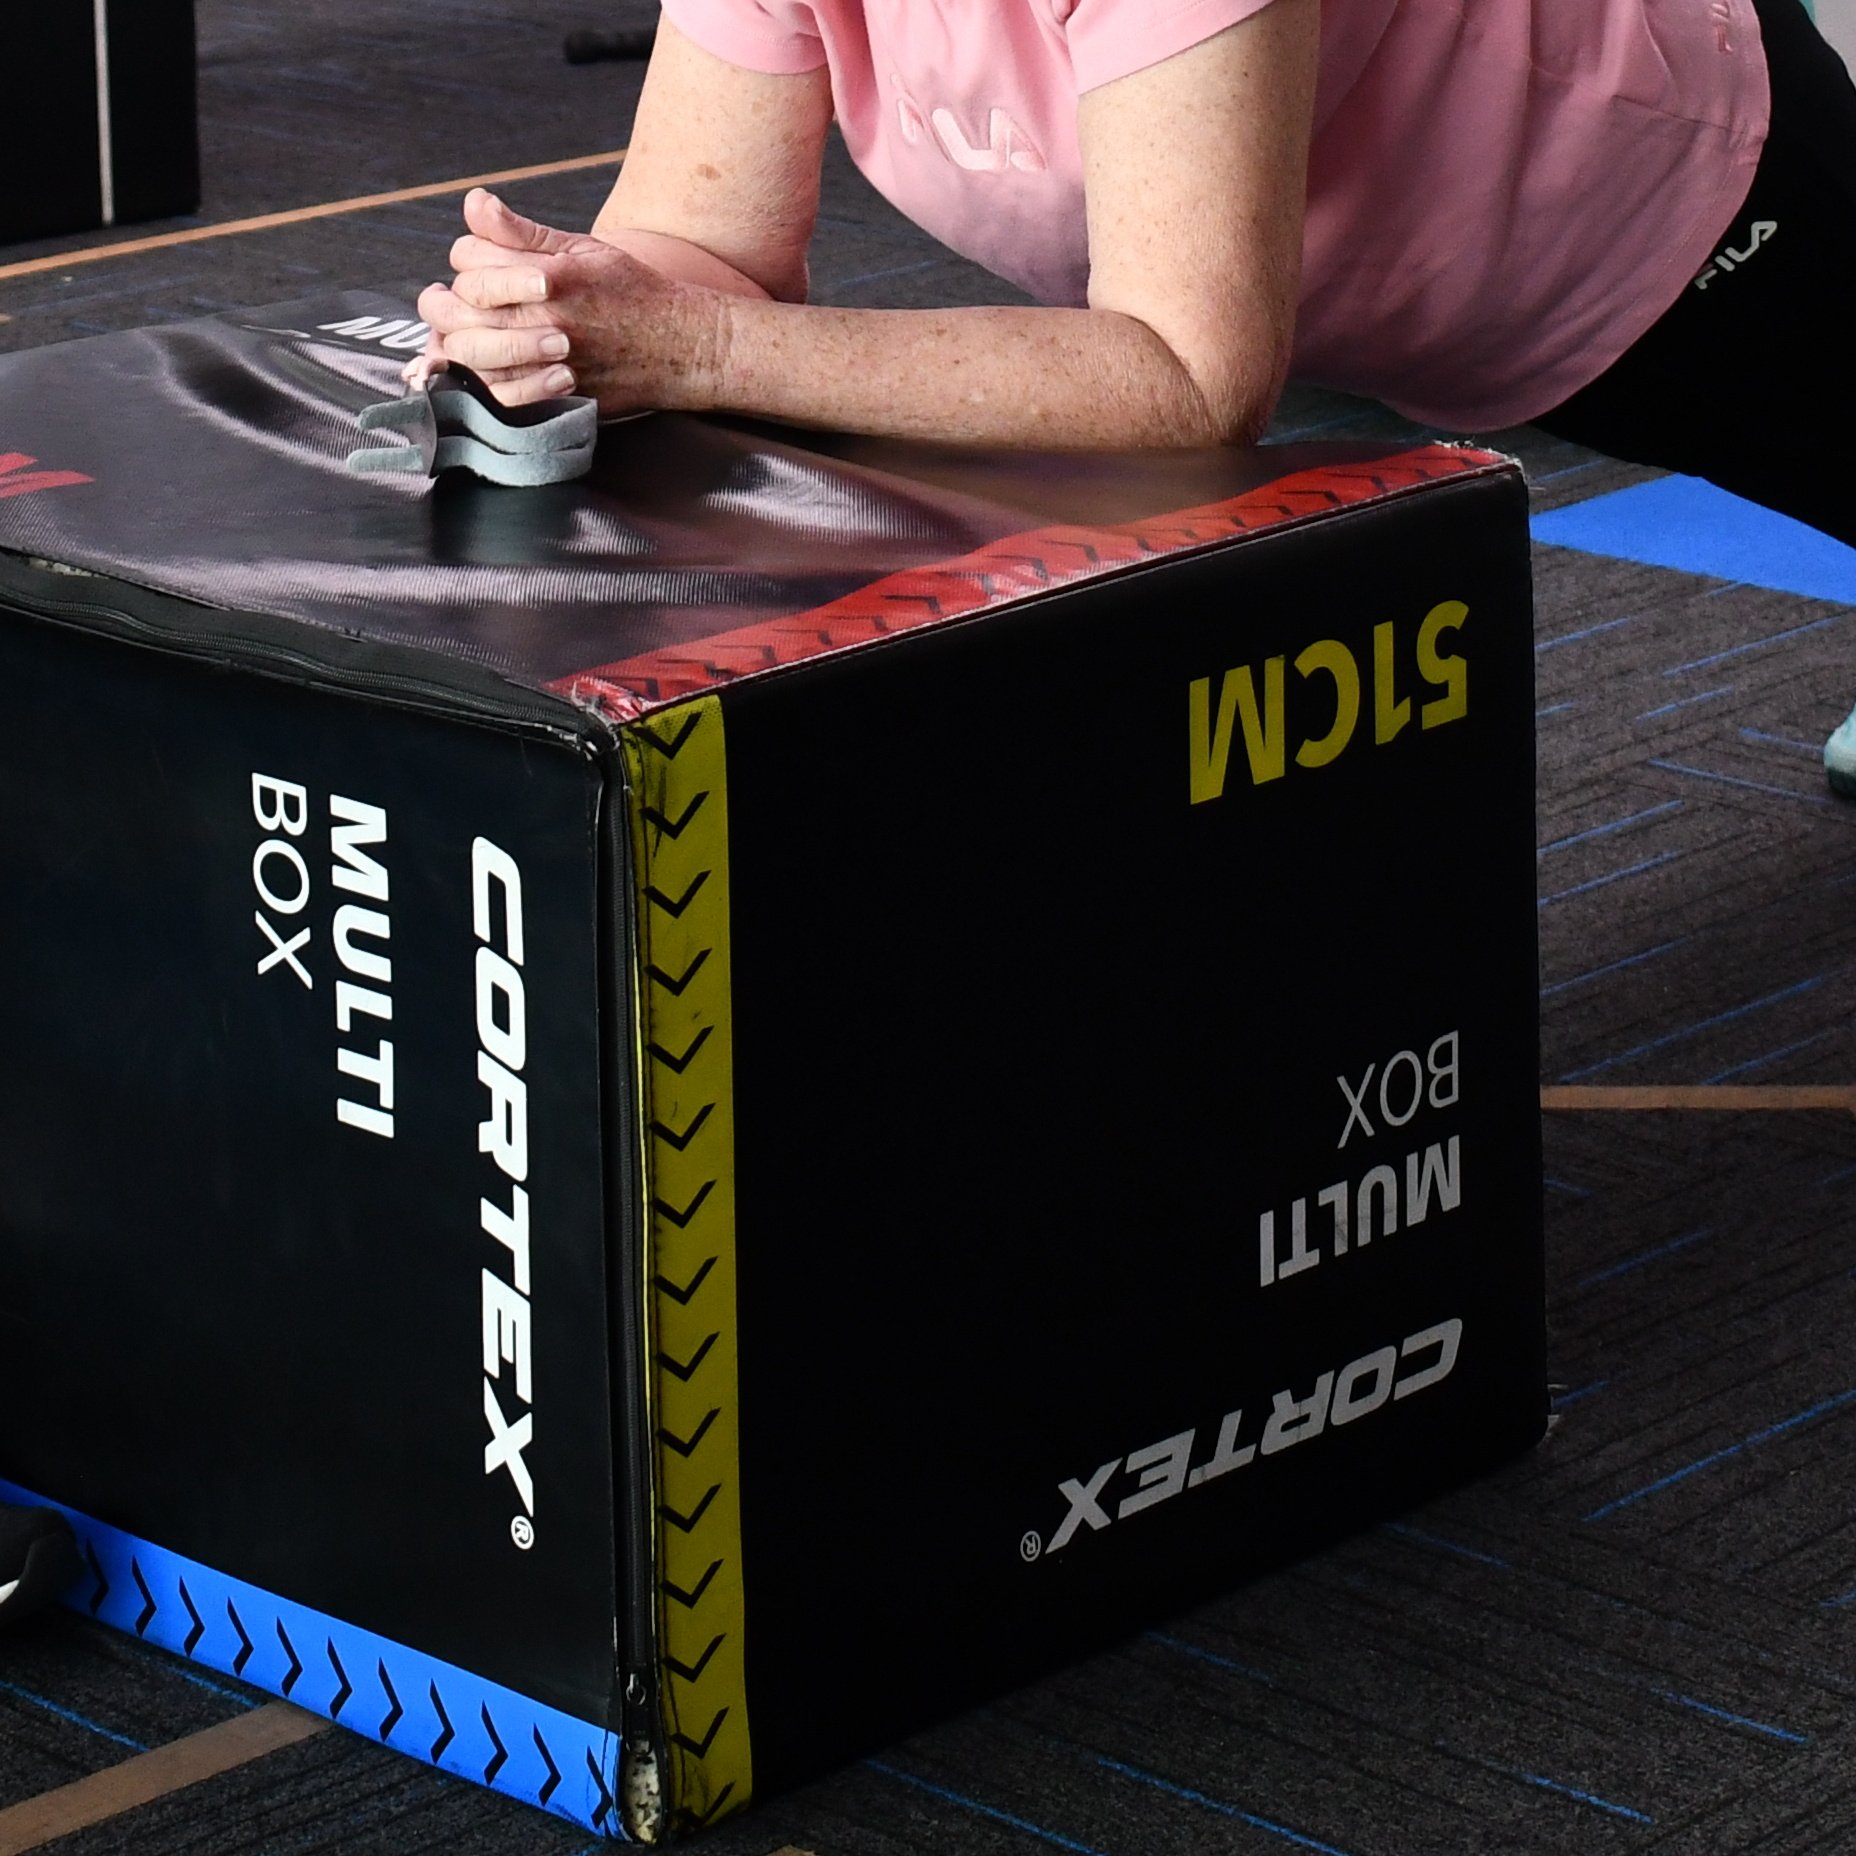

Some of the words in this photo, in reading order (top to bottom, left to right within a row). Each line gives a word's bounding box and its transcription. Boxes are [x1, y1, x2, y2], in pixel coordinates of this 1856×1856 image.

[316, 316, 432, 353] MU
[1190, 600, 1470, 805] 51CM
[251, 772, 313, 990] BOX
[329, 794, 395, 1139] MULTI
[1337, 1030, 1460, 1149] BOX
[1259, 1135, 1462, 1288] MULTI
